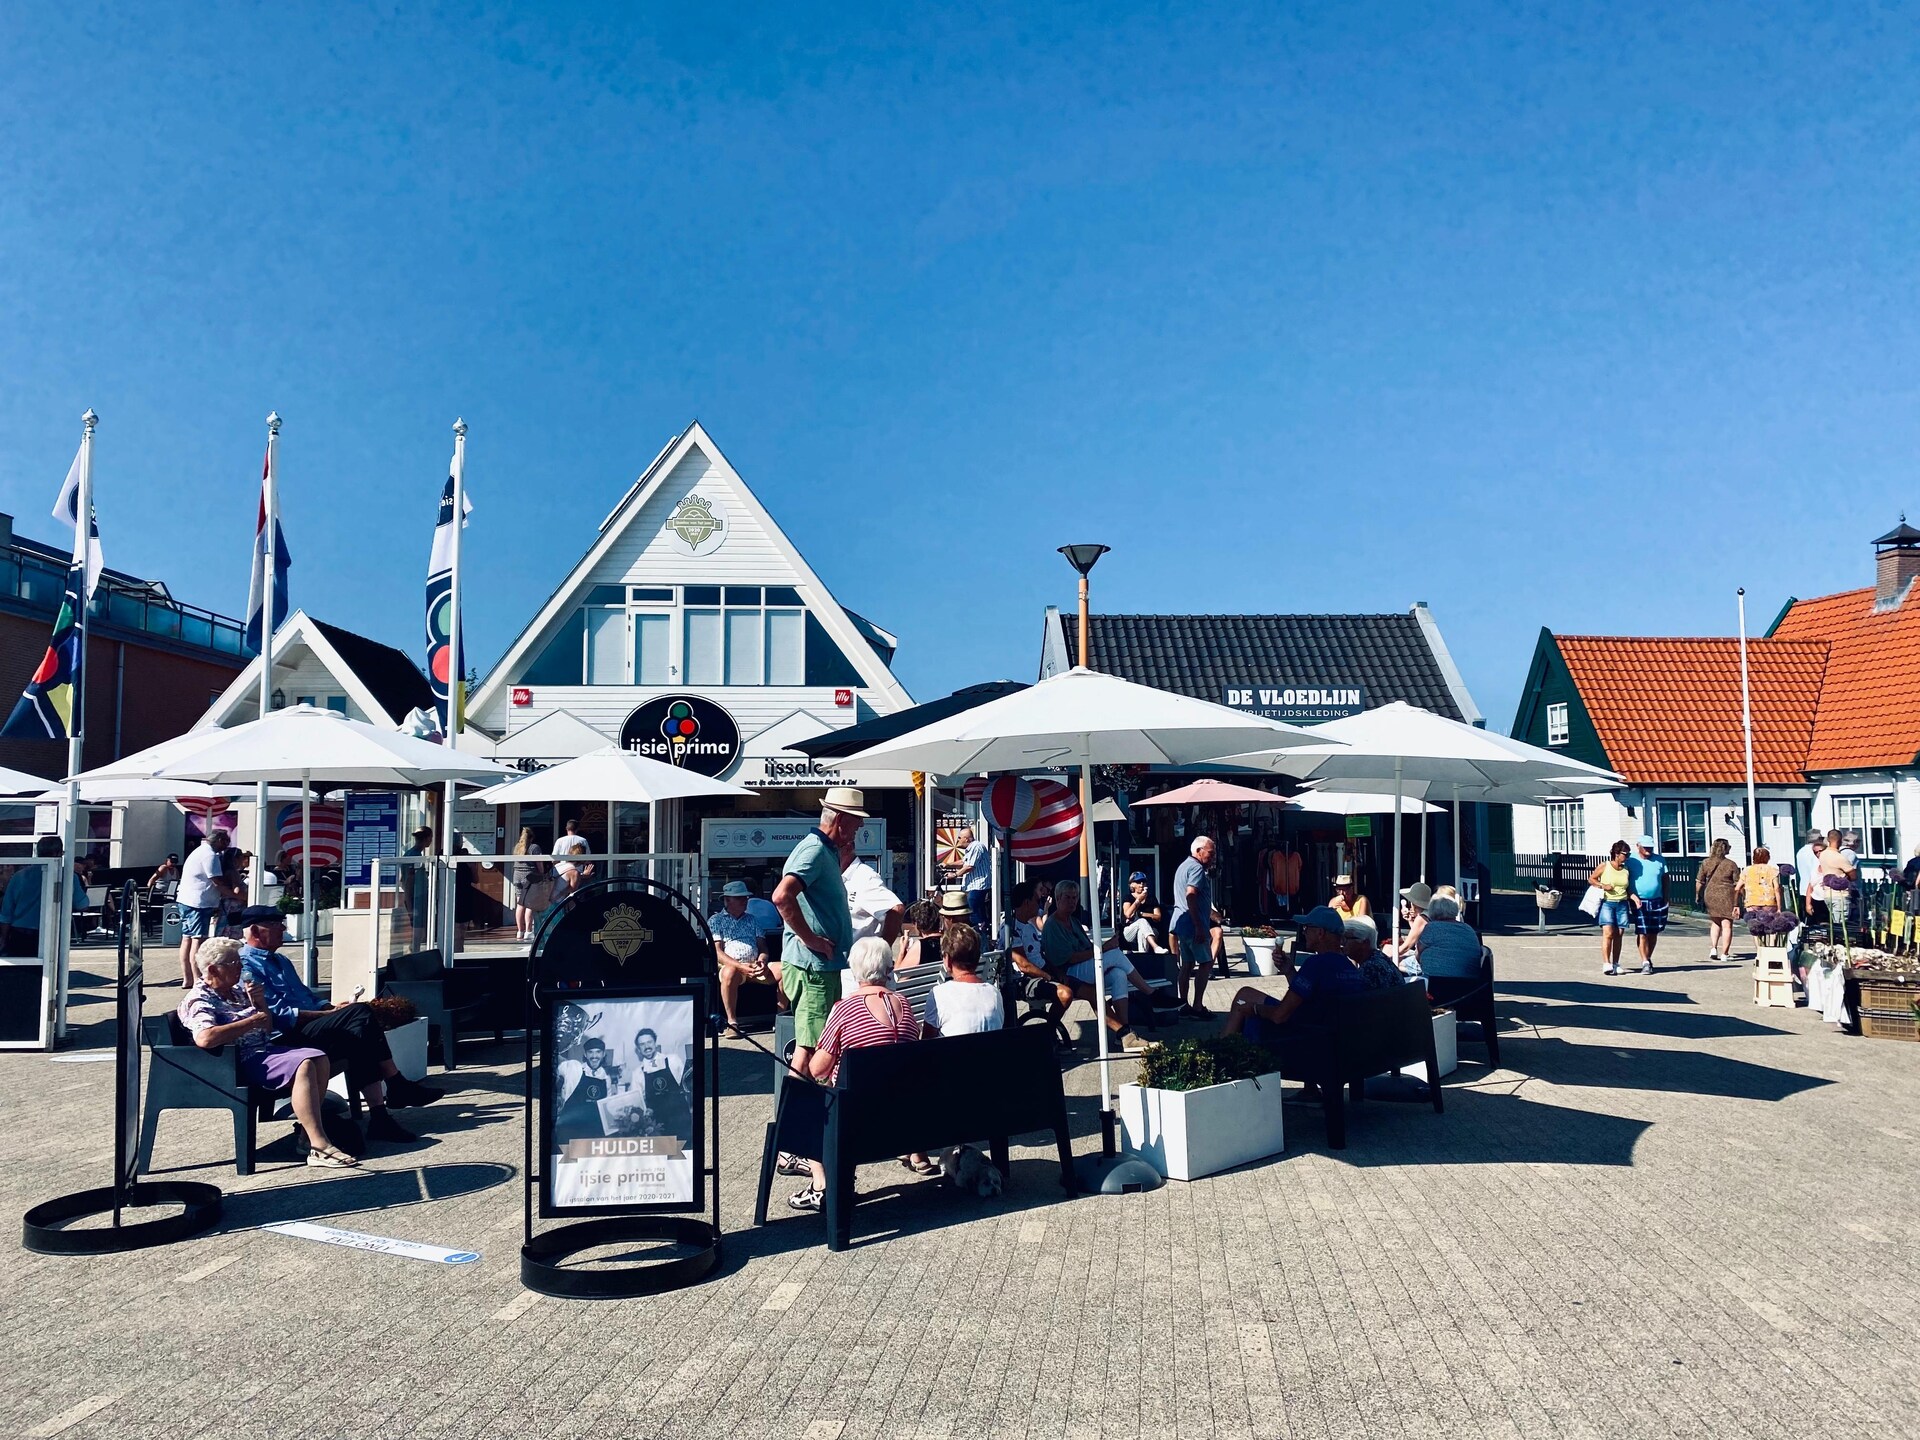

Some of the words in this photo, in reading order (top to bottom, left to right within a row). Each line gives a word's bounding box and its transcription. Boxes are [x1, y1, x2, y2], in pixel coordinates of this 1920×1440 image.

[513, 690, 529, 704] illy
[835, 691, 850, 704] illy
[1227, 689, 1253, 705] DE
[1259, 689, 1360, 705] VLOEDLIJN
[630, 738, 668, 755] ijsie
[674, 738, 730, 759] prima
[591, 1139, 654, 1155] HULDE!
[580, 1170, 611, 1187] ijsie
[617, 1168, 665, 1186] prima
[623, 1194, 637, 1202] jaar
[639, 1192, 675, 1200] 2020-2021
